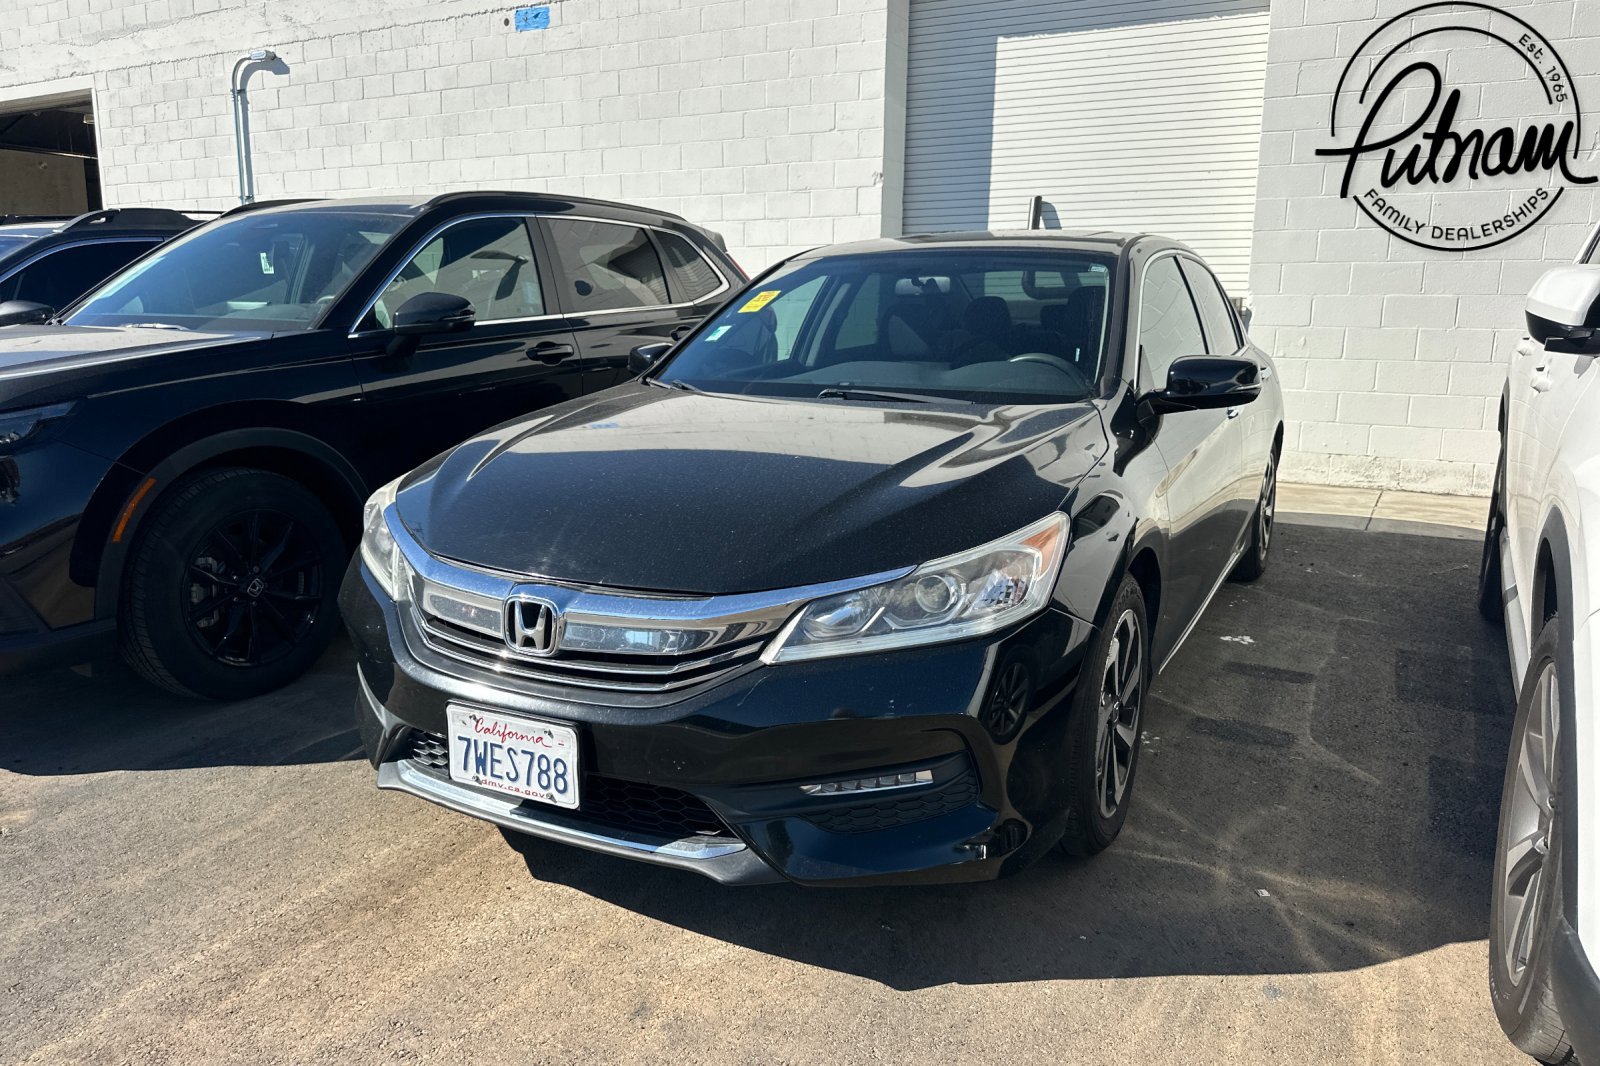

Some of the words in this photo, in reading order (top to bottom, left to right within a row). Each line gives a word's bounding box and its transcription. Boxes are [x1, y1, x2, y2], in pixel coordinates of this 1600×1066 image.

[474, 717, 552, 748] California
[457, 735, 568, 794] 7WES788
[481, 778, 546, 799] dmv.ca.gov
